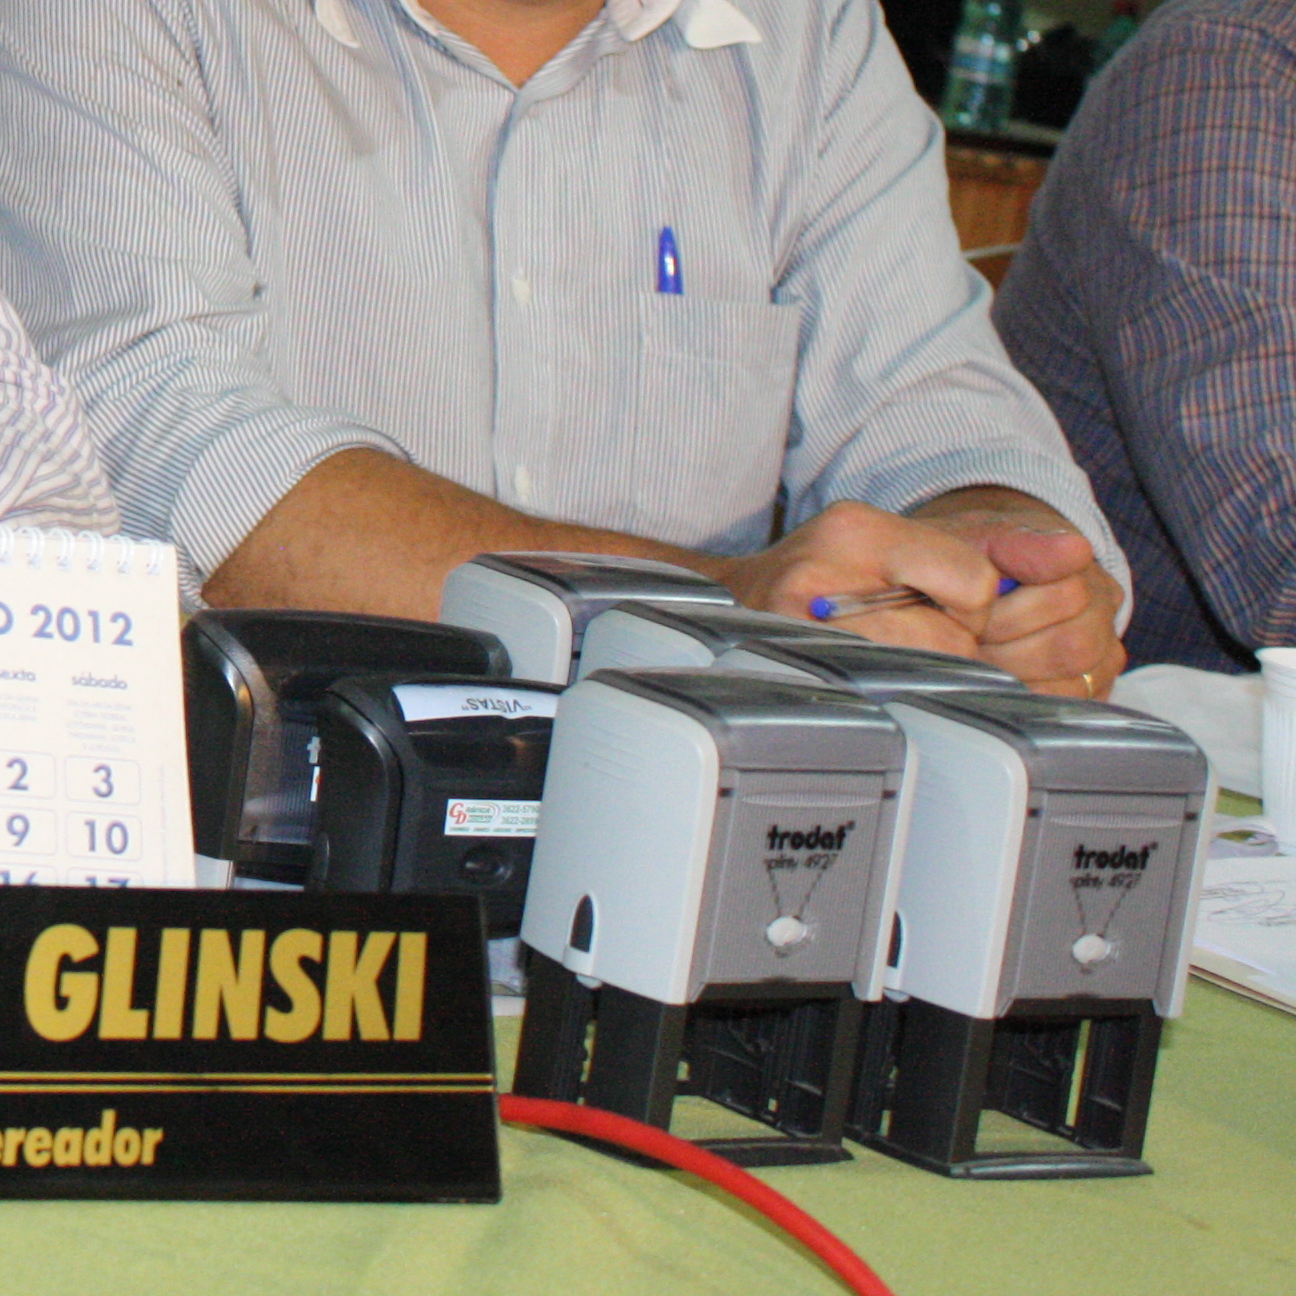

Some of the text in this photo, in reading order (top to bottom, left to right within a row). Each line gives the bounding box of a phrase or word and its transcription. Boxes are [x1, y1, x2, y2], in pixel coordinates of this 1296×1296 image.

[30, 603, 134, 647] 2012
[71, 670, 128, 690] sábado
[6, 757, 29, 791] 2
[92, 764, 115, 799] 3
[6, 813, 31, 847] 9
[84, 819, 129, 855] 10
[767, 823, 847, 852] trodat
[1073, 844, 1151, 871] trodat
[23, 922, 428, 1042] GLINSKI
